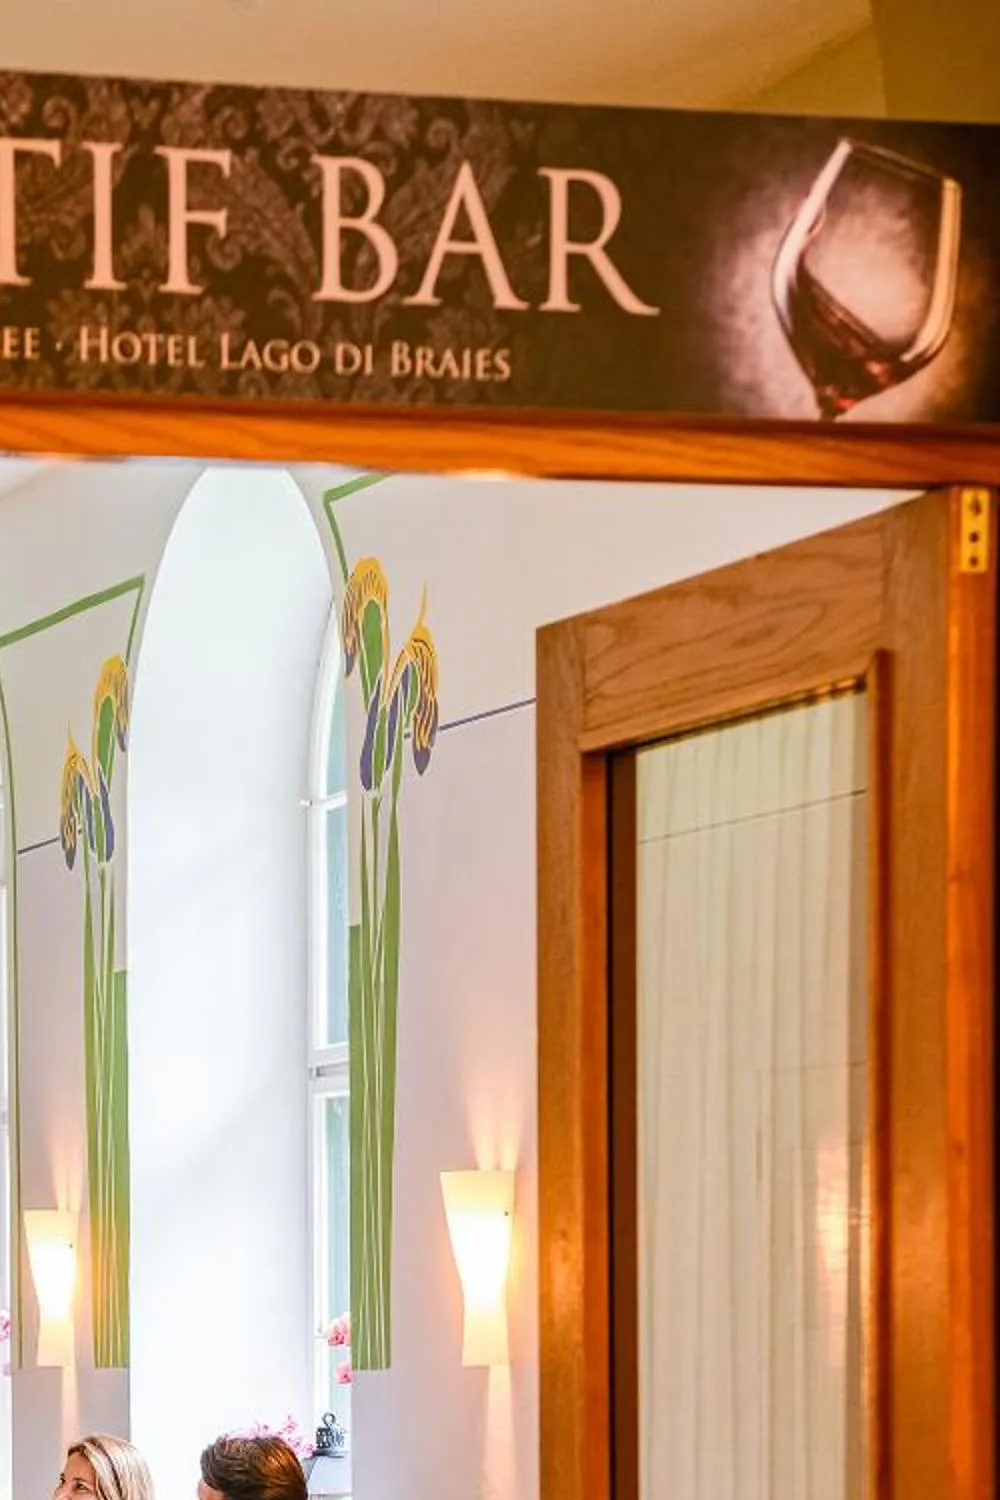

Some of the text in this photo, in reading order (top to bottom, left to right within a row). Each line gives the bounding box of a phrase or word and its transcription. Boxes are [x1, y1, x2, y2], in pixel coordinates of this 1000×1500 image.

[310, 153, 660, 316] BAR
[79, 325, 206, 369] HOTEL
[220, 332, 322, 373] LAGO
[391, 341, 512, 382] BRAIES
